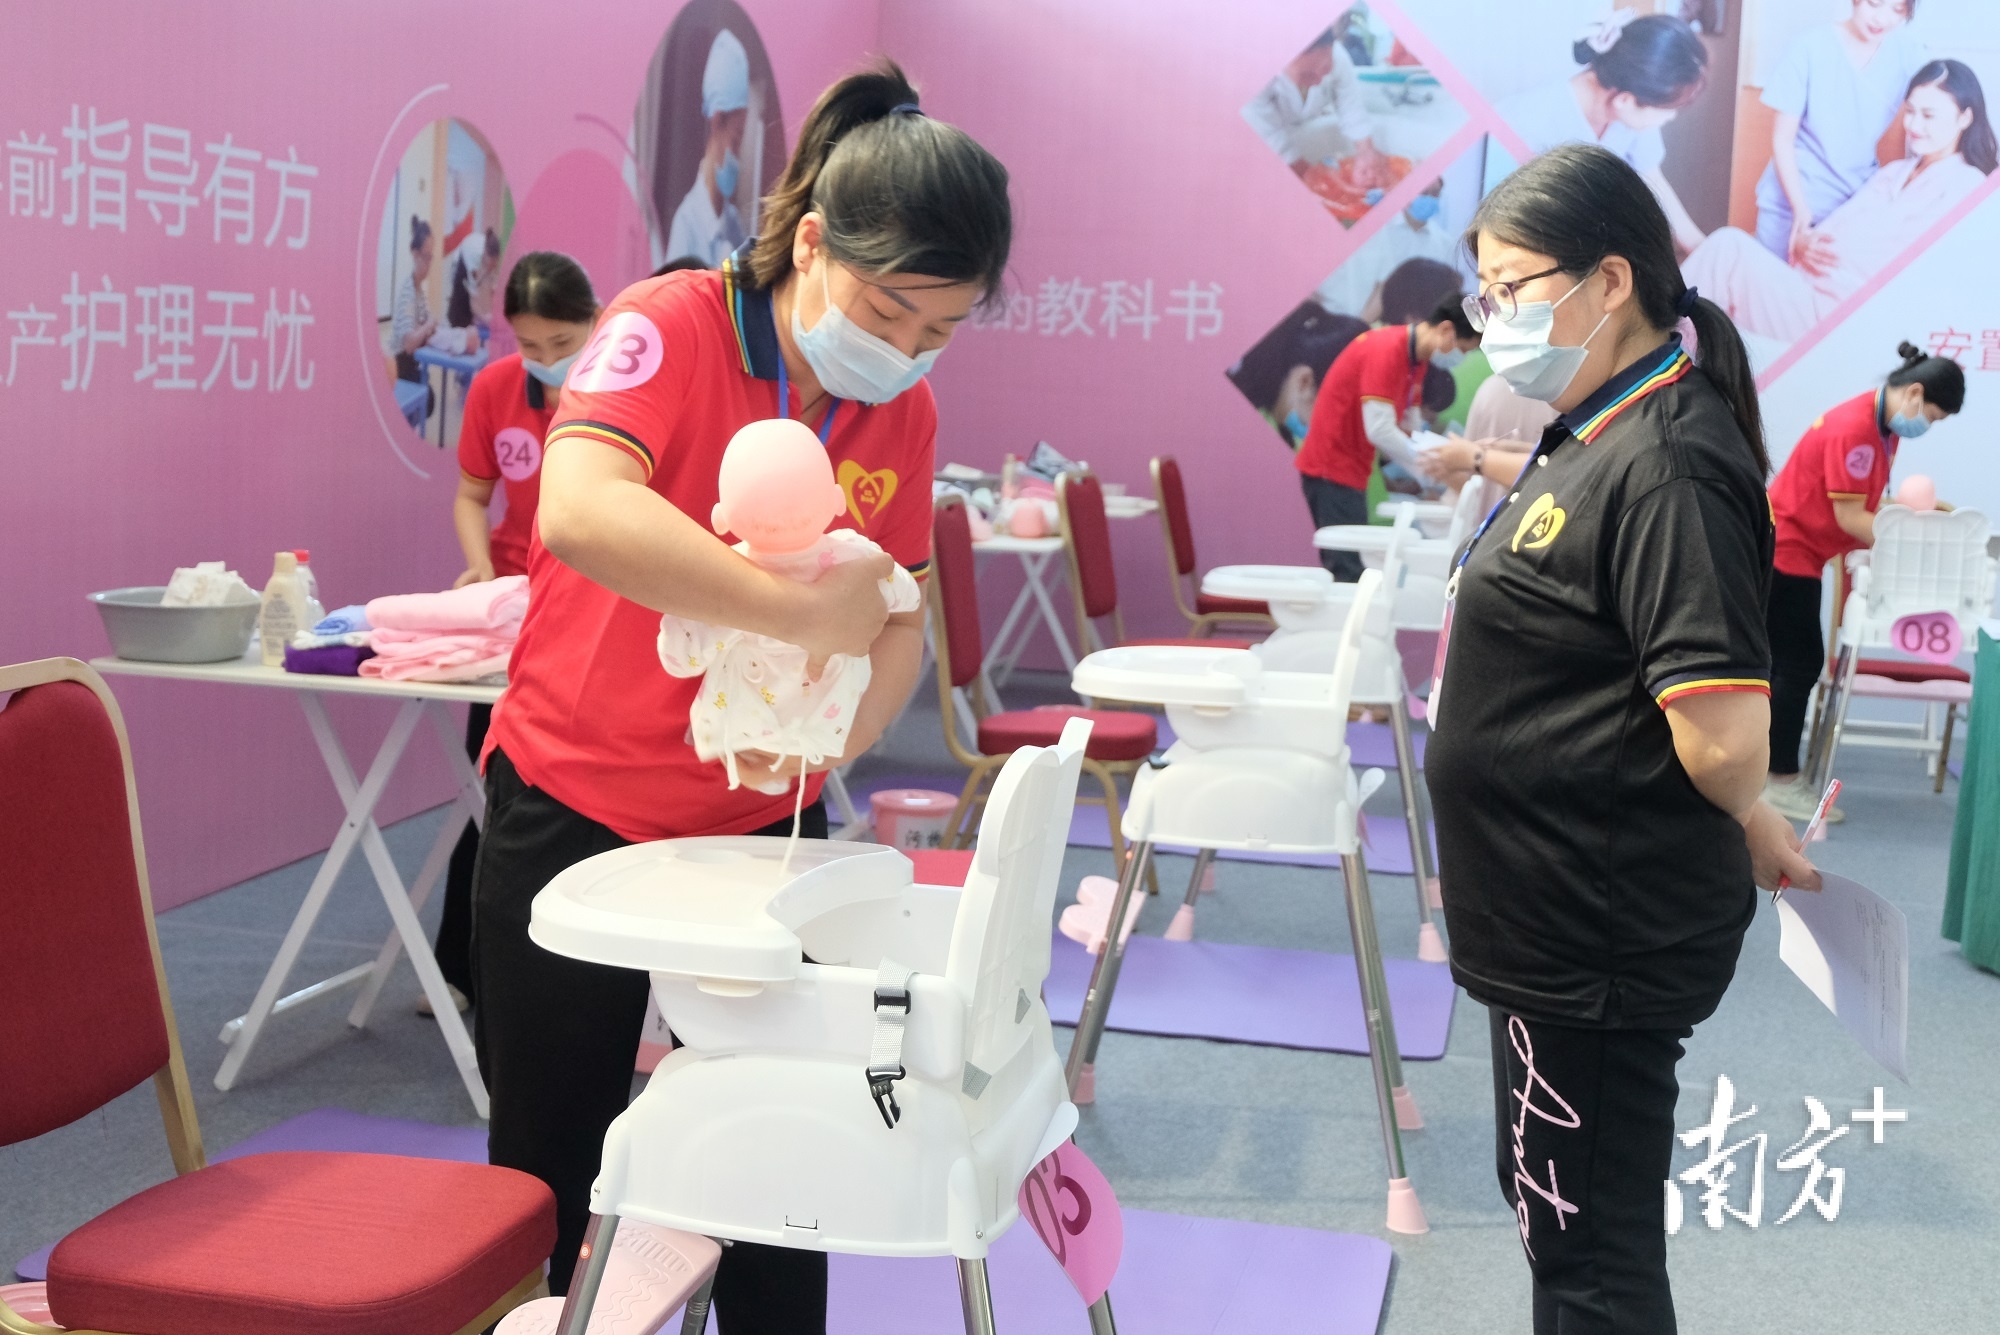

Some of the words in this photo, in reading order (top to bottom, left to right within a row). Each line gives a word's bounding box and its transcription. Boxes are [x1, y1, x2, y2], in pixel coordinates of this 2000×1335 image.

[0, 103, 319, 249] 前指导有方
[0, 271, 316, 392] 产护理无忧
[576, 333, 648, 376] 23
[499, 441, 534, 467] 24
[1900, 619, 1951, 654] 08
[1024, 1149, 1092, 1268] 03
